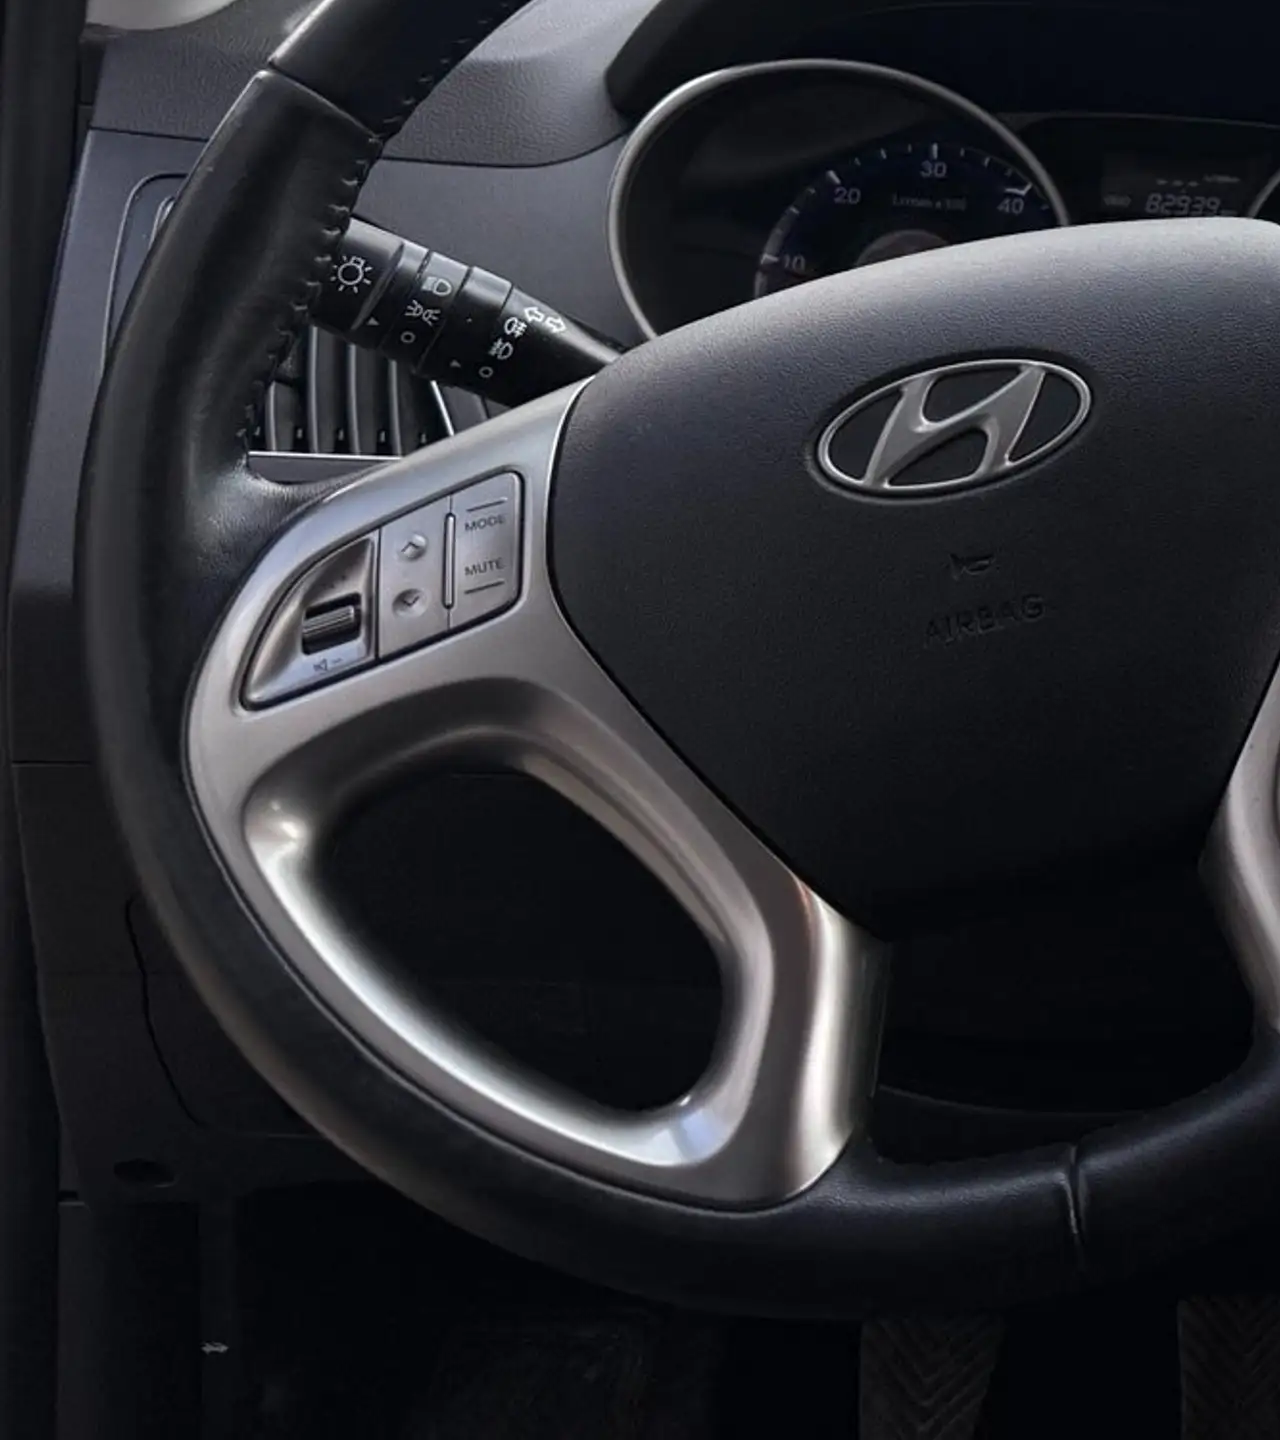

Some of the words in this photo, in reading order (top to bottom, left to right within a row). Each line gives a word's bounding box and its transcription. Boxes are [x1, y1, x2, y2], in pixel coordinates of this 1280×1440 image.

[920, 161, 948, 178] 30
[833, 186, 861, 205] 20
[464, 514, 505, 531] MODE
[464, 558, 505, 576] MUTE
